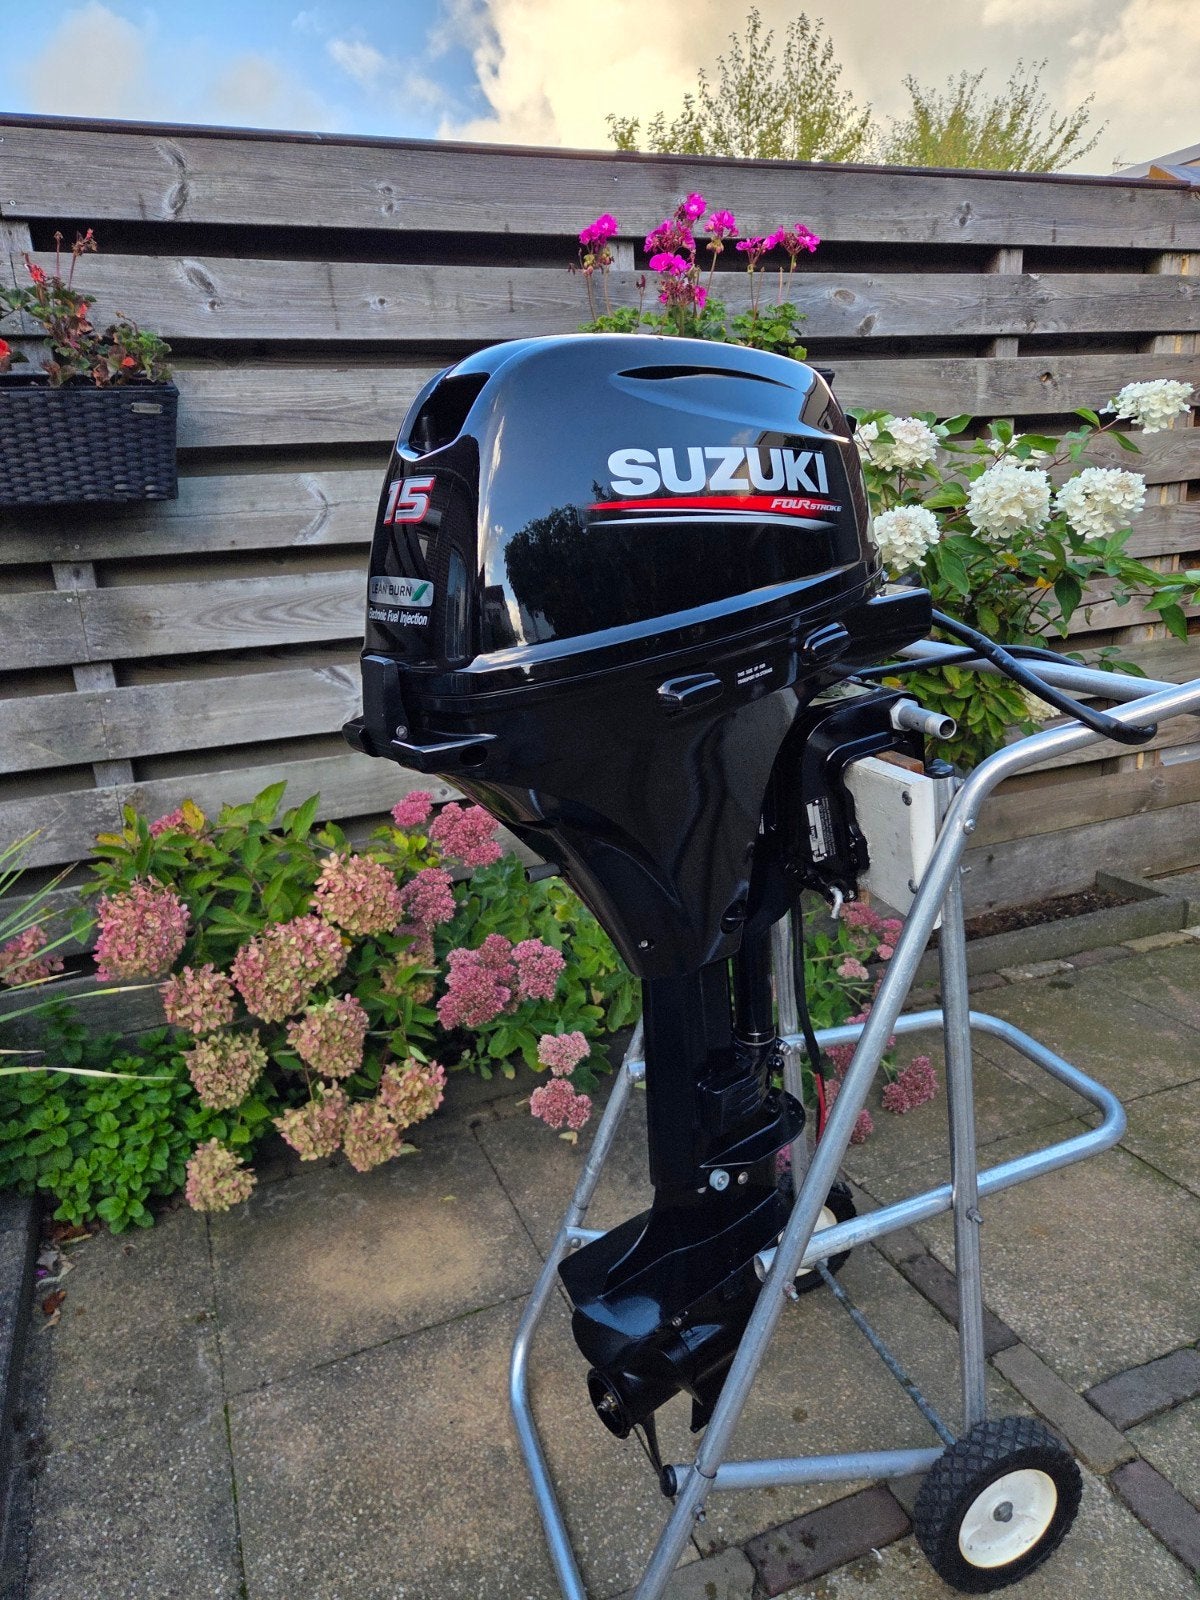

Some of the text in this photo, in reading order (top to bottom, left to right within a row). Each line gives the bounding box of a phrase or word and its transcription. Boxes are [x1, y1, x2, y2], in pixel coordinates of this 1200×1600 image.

[607, 446, 829, 496] SUZUKI
[383, 475, 437, 525] 15
[770, 498, 843, 512] FOUR STROKE
[389, 585, 412, 597] BURN
[387, 609, 400, 623] Fuel
[400, 611, 428, 627] Injection
